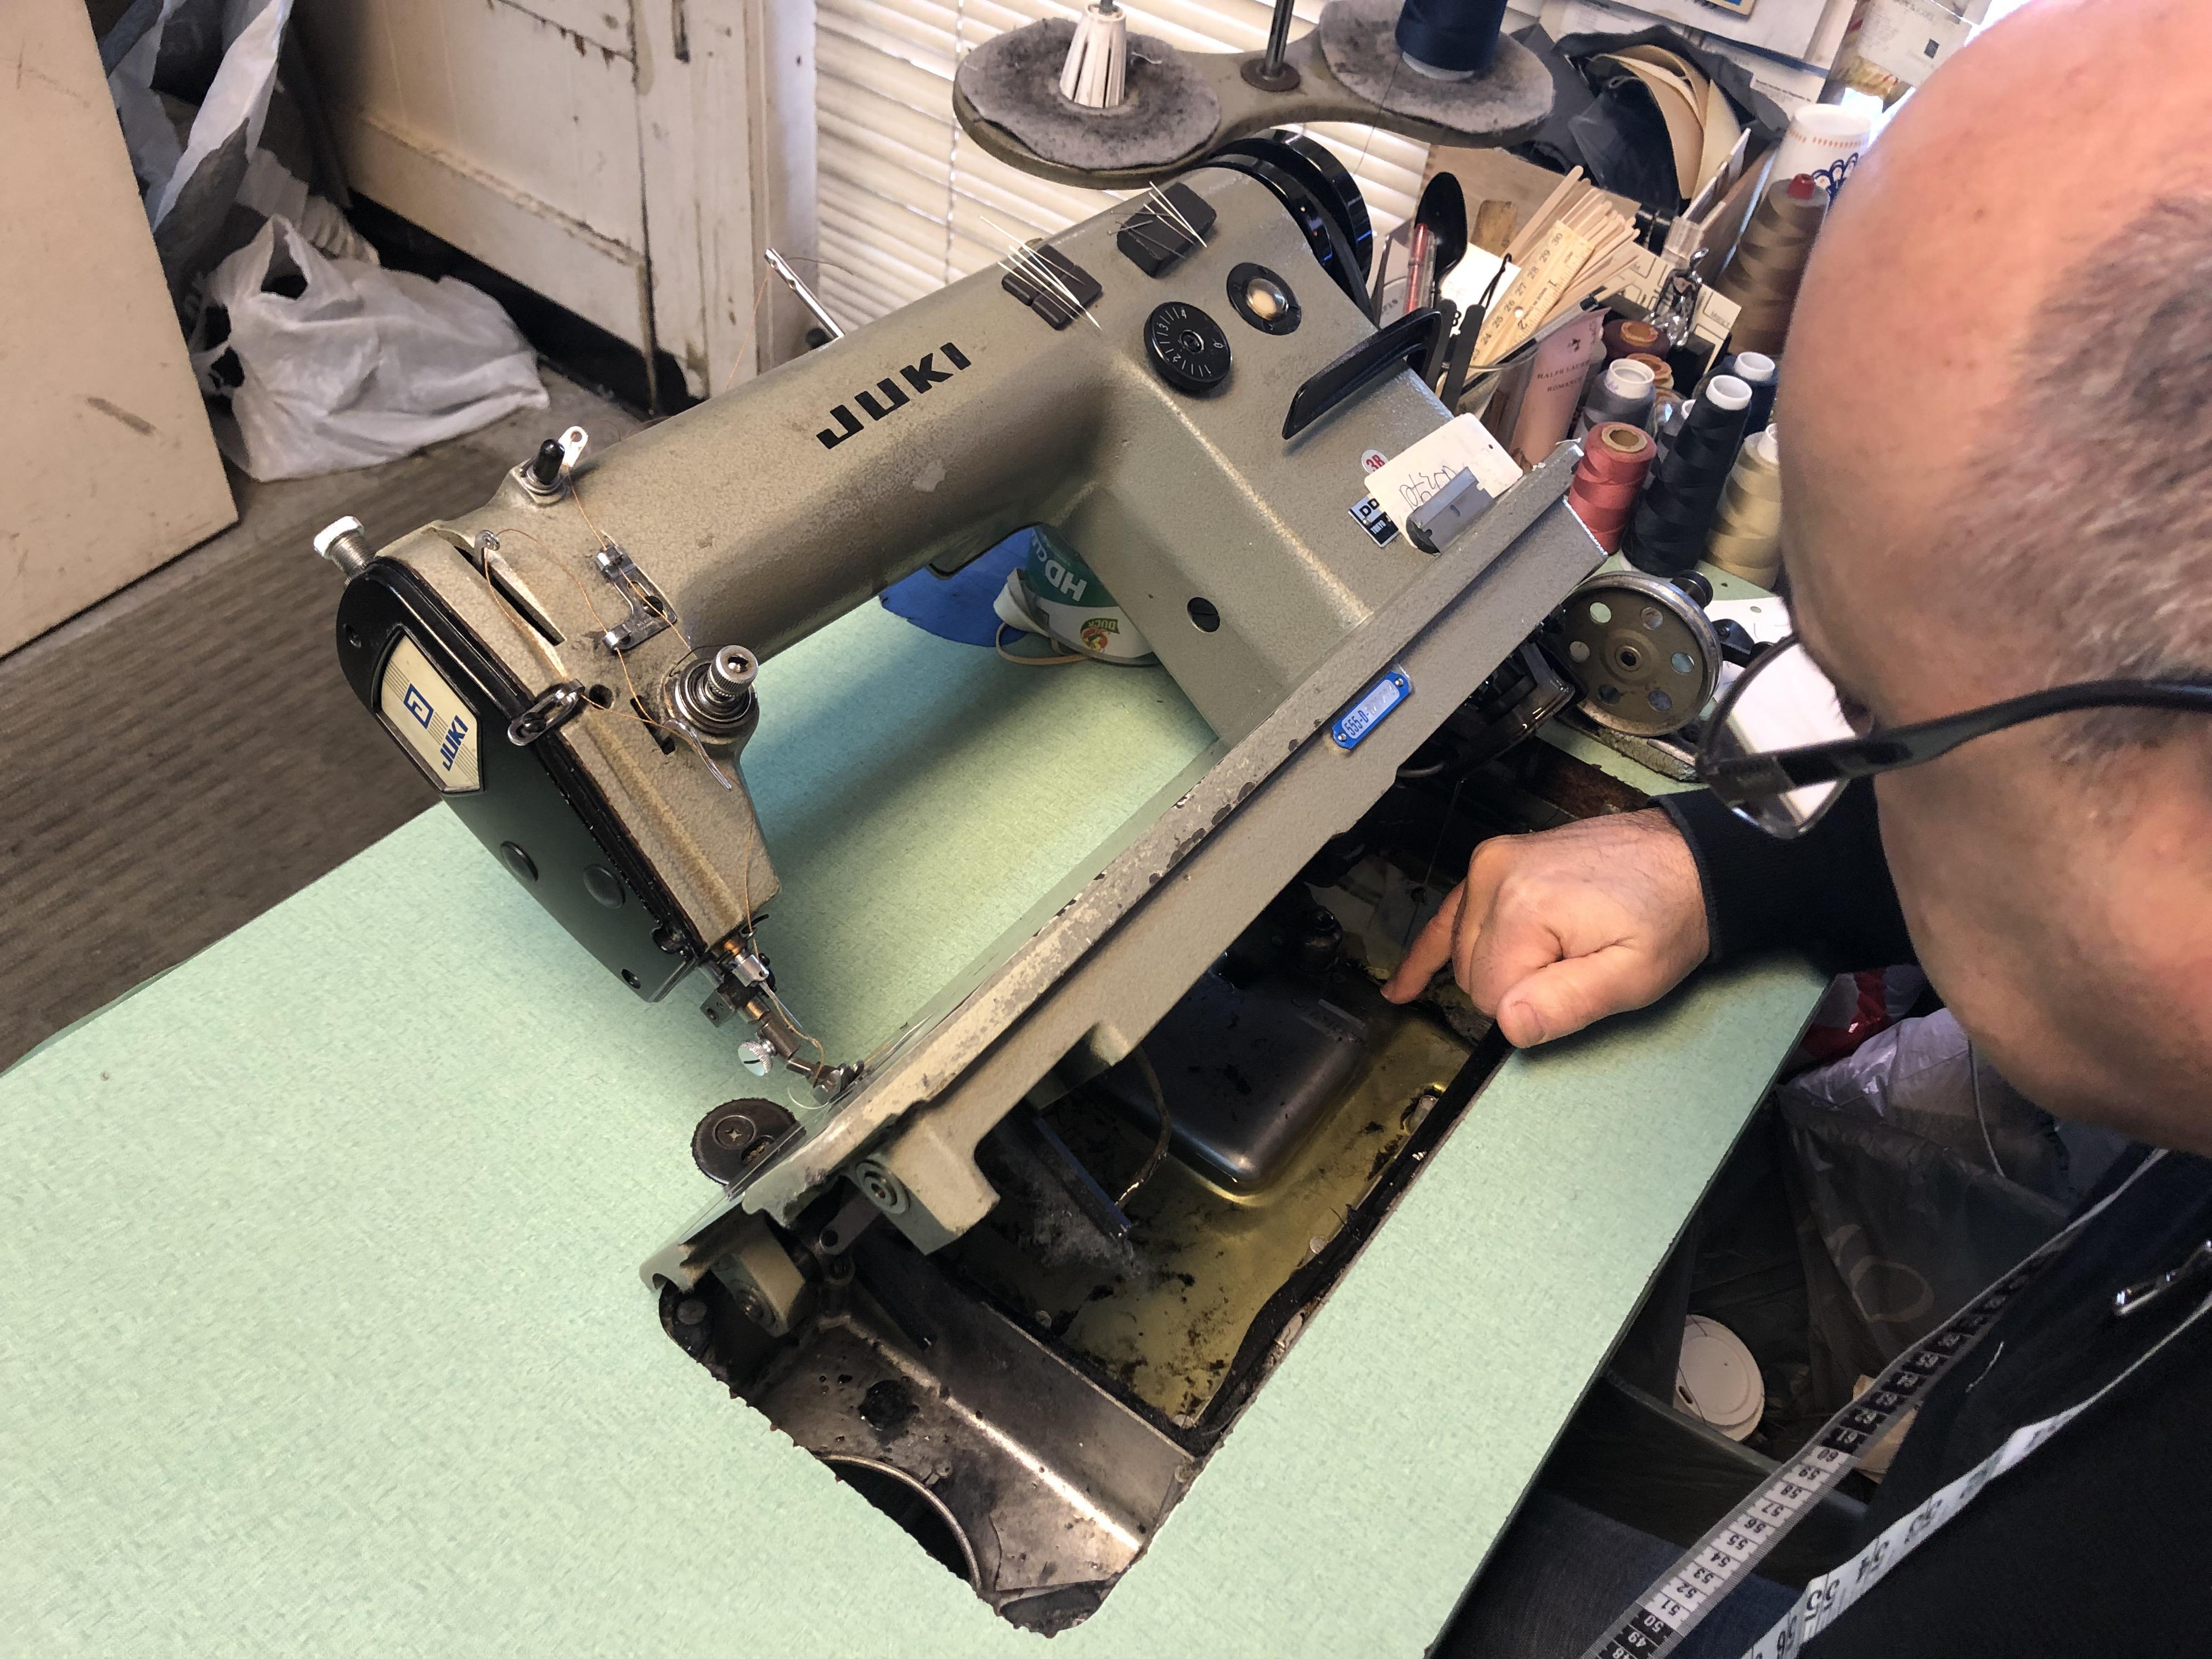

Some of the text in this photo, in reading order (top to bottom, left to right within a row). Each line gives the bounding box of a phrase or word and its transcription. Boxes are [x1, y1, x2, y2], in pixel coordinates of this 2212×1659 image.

[1551, 233, 1563, 246] 30
[1539, 250, 1550, 263] 29
[1527, 266, 1539, 280] 28
[1515, 281, 1527, 296] 27
[1548, 279, 1558, 288] 1
[1181, 308, 1187, 319] 4
[1504, 300, 1515, 312] 26
[1158, 323, 1169, 331] 3
[1492, 315, 1503, 329] 25
[1517, 320, 1528, 330] 2
[816, 342, 972, 450] JUKI
[1370, 520, 1387, 535] TOKYO
[1045, 559, 1087, 602] HD
[440, 715, 469, 771] JUKI
[1817, 1449, 1839, 1463] 60
[1798, 1468, 1820, 1481] 59
[1780, 1485, 1802, 1499] 58
[1761, 1502, 1783, 1517] 57
[1744, 1518, 1766, 1533] 56
[1726, 1534, 1748, 1550] 55
[1711, 1551, 1731, 1567] 54
[1694, 1567, 1714, 1584] 53
[1677, 1582, 1697, 1599] 52
[1661, 1599, 1680, 1616] 51
[1644, 1615, 1664, 1633] 50
[1628, 1631, 1646, 1647] 49
